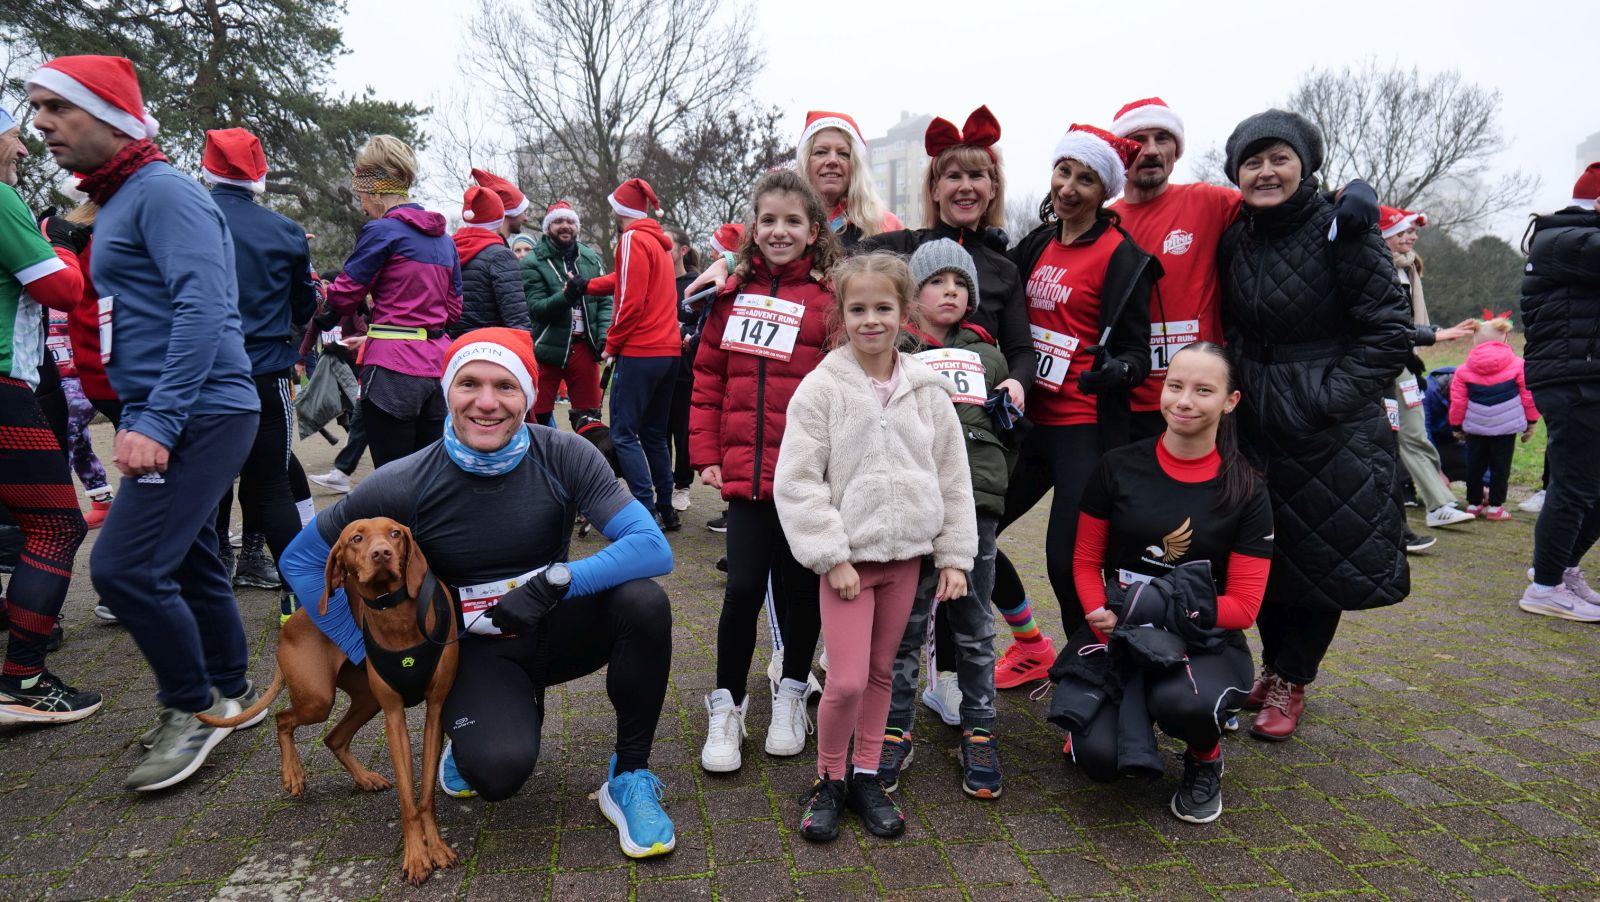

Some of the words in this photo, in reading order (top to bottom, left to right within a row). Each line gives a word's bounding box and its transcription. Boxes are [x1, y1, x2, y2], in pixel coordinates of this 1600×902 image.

[1026, 280, 1073, 305] MARATON
[740, 318, 780, 347] 147
[1150, 335, 1177, 344] DVENT
[453, 347, 502, 370] BAGATIN
[941, 370, 970, 394] 6
